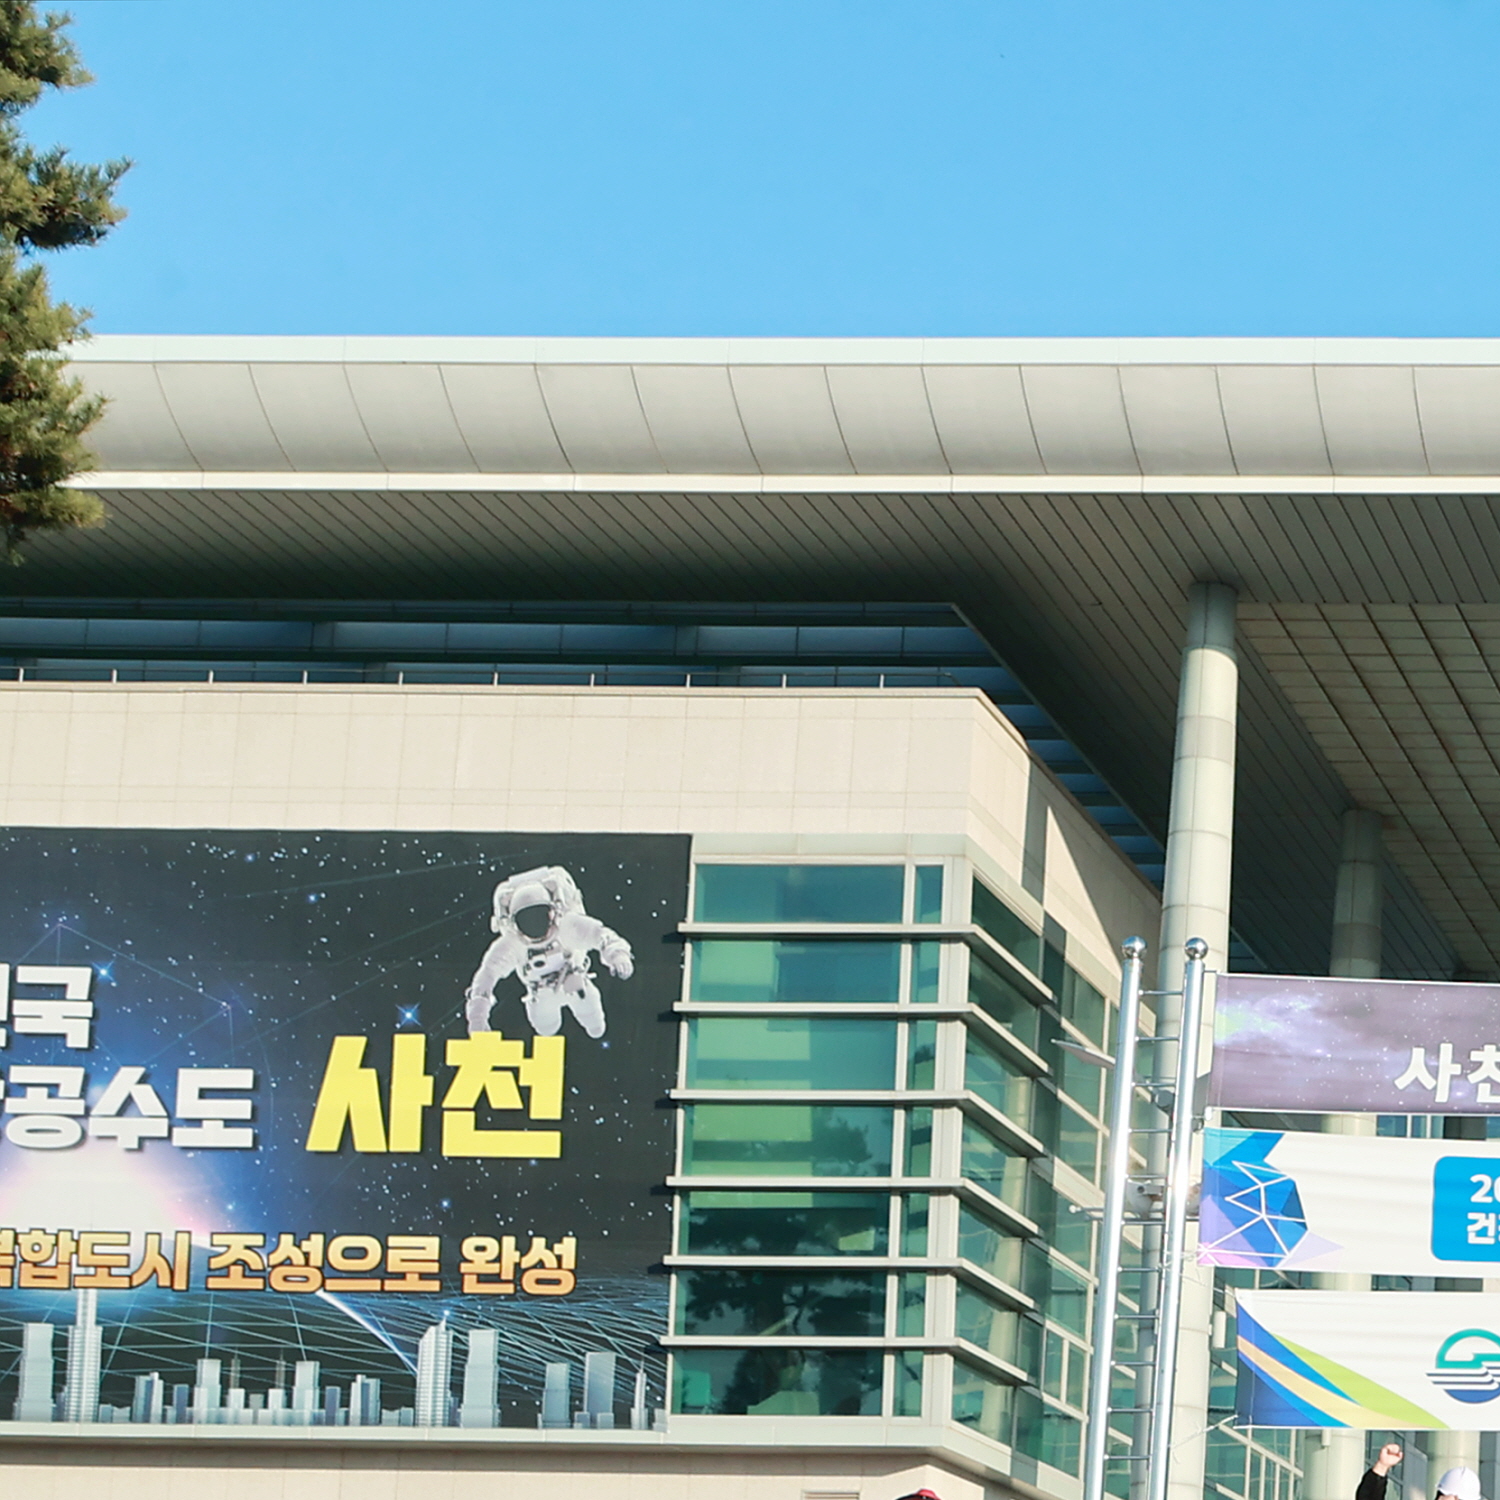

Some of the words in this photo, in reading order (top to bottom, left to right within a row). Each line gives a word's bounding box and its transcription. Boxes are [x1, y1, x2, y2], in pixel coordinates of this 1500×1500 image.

[0, 963, 93, 1048] 국
[0, 1065, 254, 1150] 공수도
[306, 1032, 565, 1158] 사천
[206, 1235, 441, 1293] 조성으로
[460, 1236, 577, 1295] 완성
